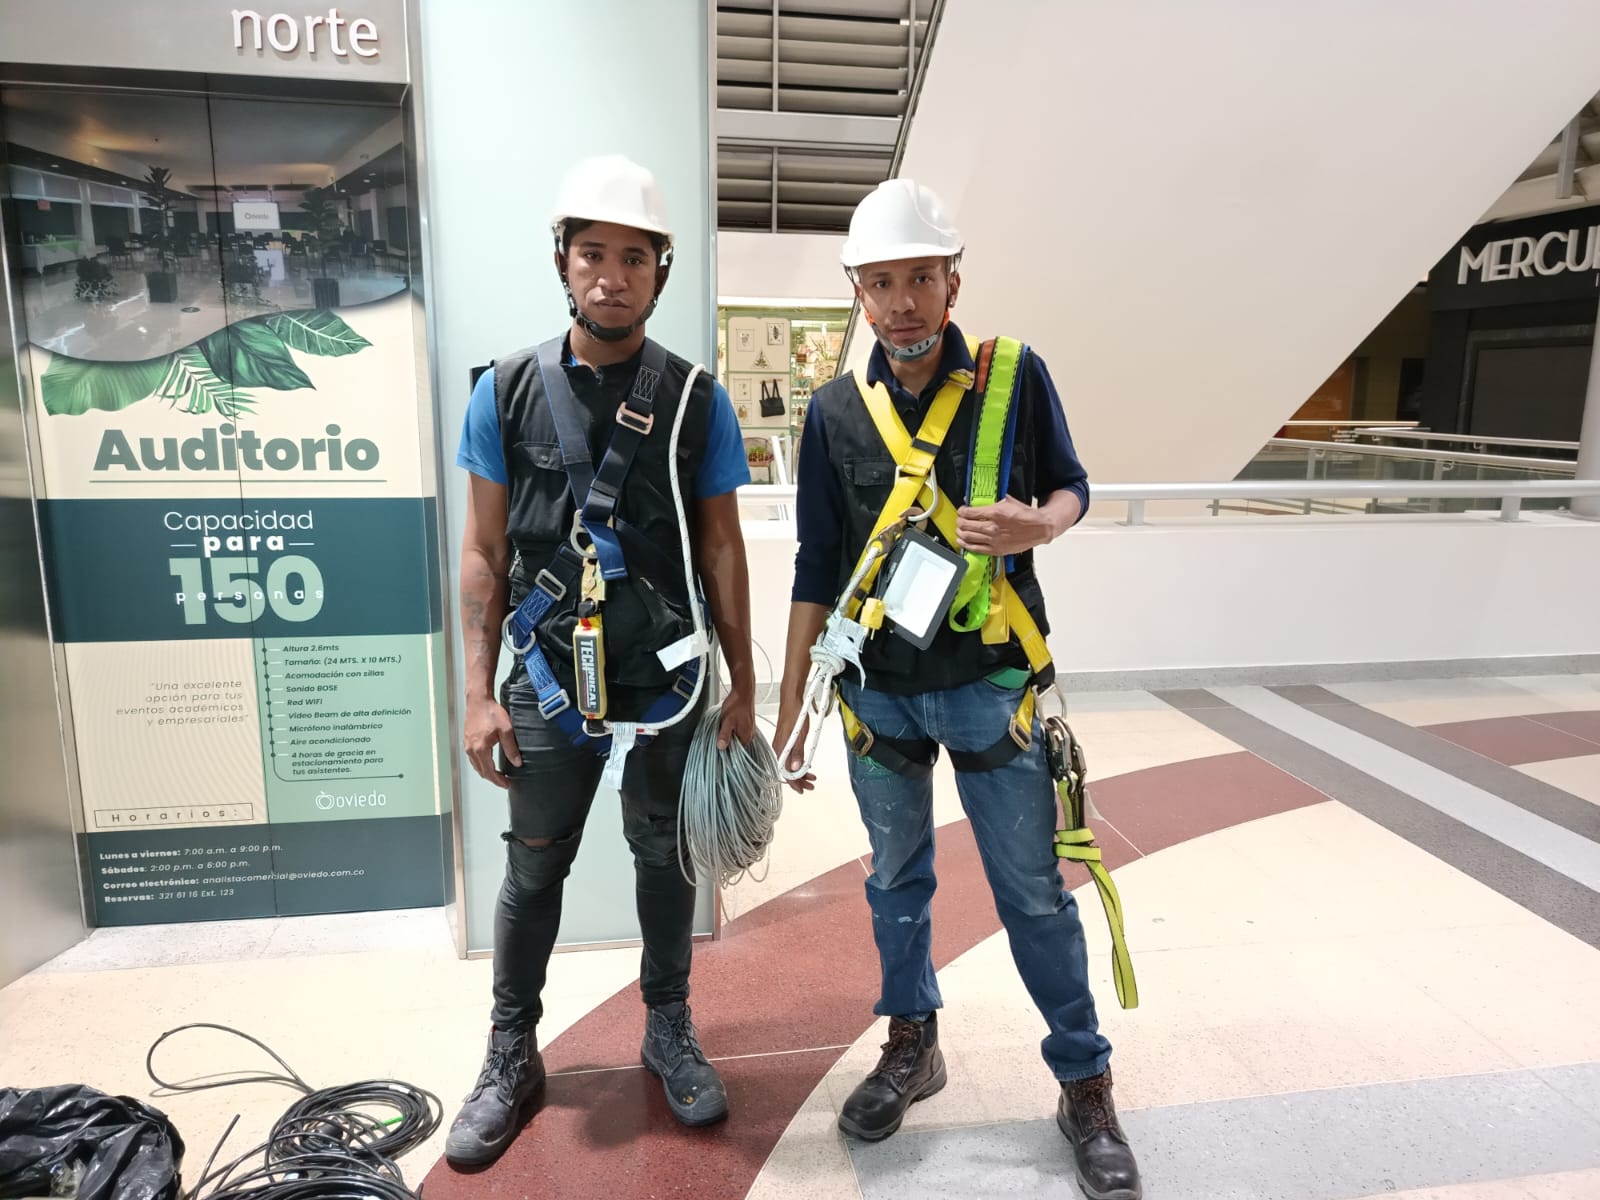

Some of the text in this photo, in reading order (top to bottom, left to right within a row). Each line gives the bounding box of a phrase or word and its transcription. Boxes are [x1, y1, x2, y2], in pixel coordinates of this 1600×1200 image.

[231, 8, 380, 57] norte
[93, 423, 380, 472] Auditorio
[164, 510, 314, 536] Capacidad
[204, 533, 284, 558] para
[168, 555, 324, 626] 150
[176, 588, 323, 605] personas
[324, 658, 337, 666] (24
[379, 655, 402, 664] MTS.)
[285, 670, 344, 679] Acomodación
[580, 640, 596, 708] TECHNICAL
[184, 680, 242, 690] excelente
[146, 692, 242, 703] opción para tus
[116, 704, 244, 716] eventos académicos
[372, 708, 412, 716] definición
[289, 723, 383, 733] Micrófono inalámbrico
[309, 736, 371, 744] acondicionado
[337, 750, 364, 758] gracia
[292, 758, 362, 767] estacionamiento
[336, 791, 386, 807] oviedo
[112, 809, 238, 822] Horarios:
[140, 850, 181, 858] viernes:
[262, 845, 283, 853] p.m.
[102, 866, 146, 874] Sábados:
[173, 864, 194, 872] p.m.
[230, 860, 250, 868] p.m.
[139, 878, 199, 888] electrónico:
[104, 894, 154, 902] Reservas:
